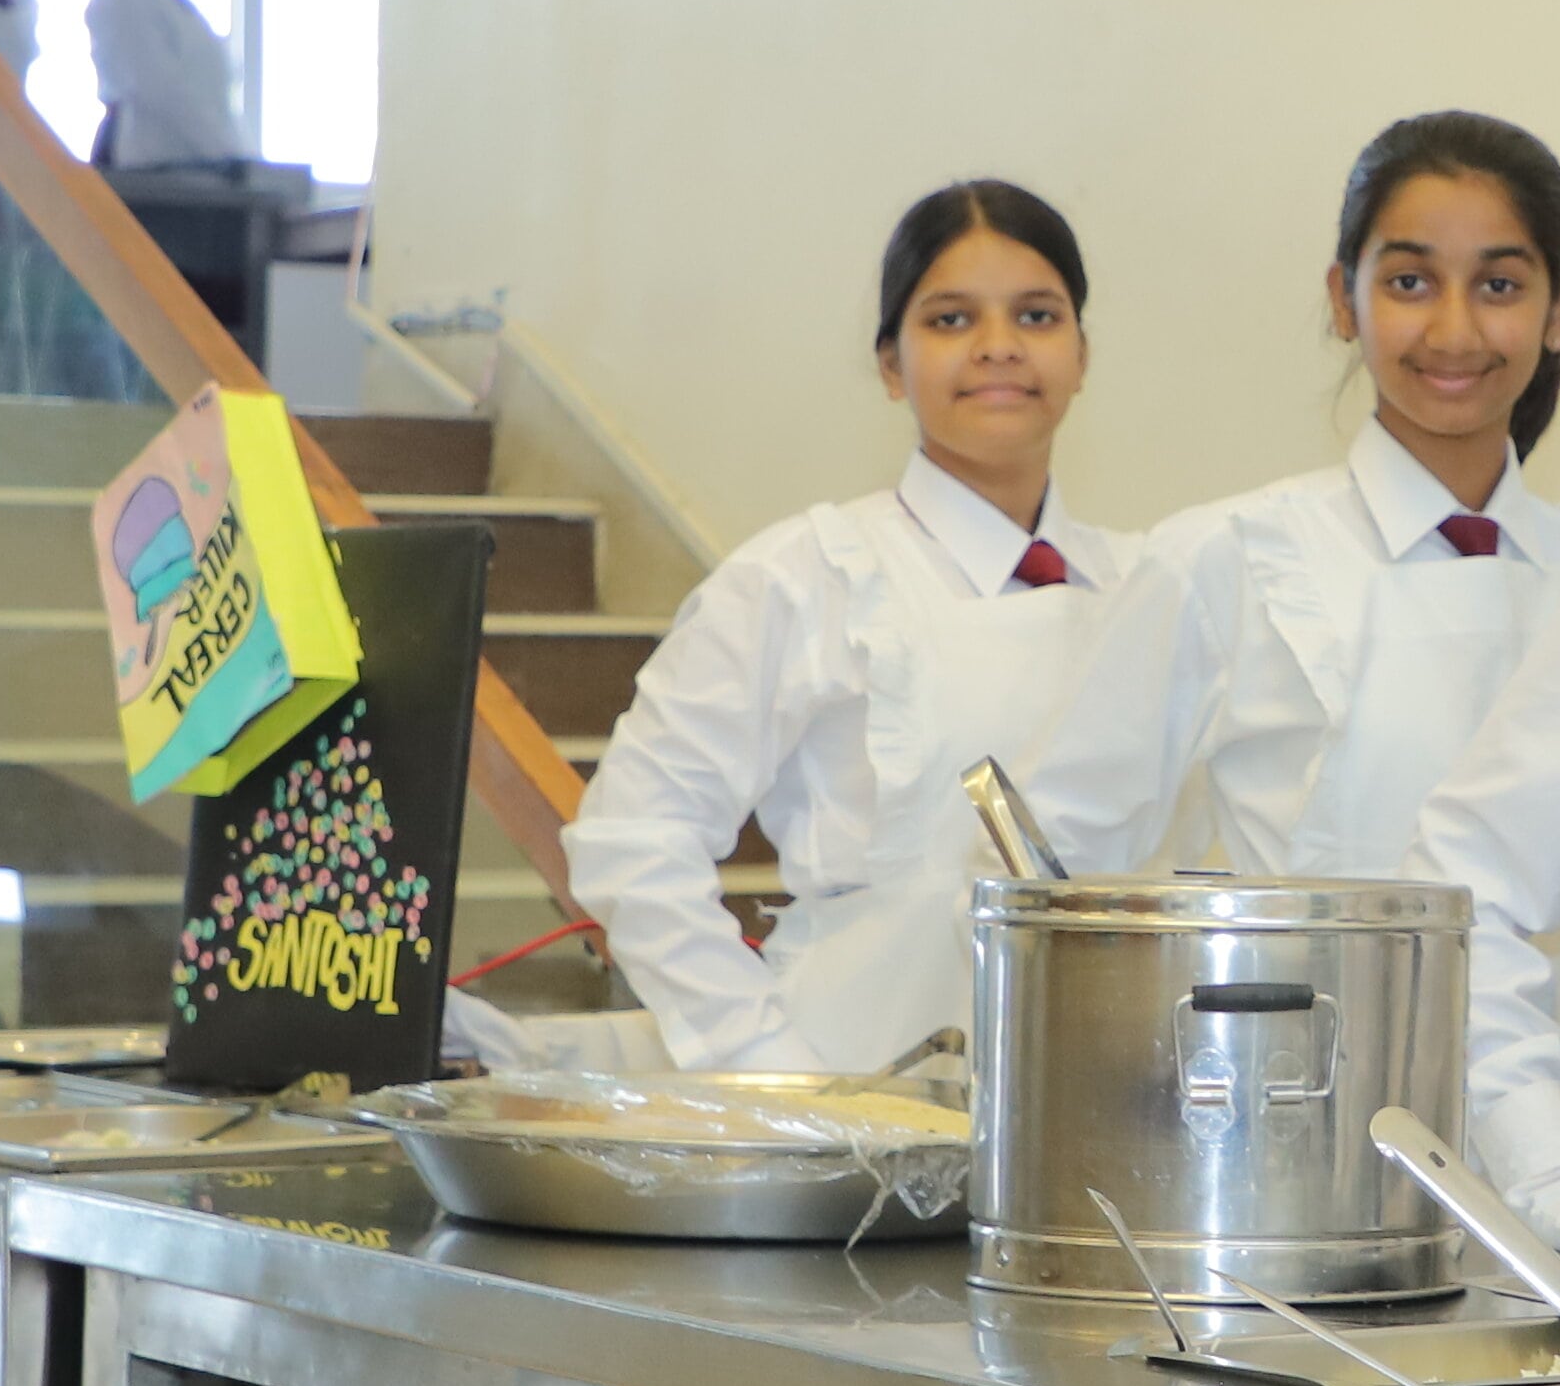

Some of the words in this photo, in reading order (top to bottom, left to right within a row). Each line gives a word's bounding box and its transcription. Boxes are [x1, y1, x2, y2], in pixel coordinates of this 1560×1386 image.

[174, 501, 243, 626] KILLER
[151, 571, 253, 713] CEREAL
[226, 909, 404, 1015] SANTOSHI
